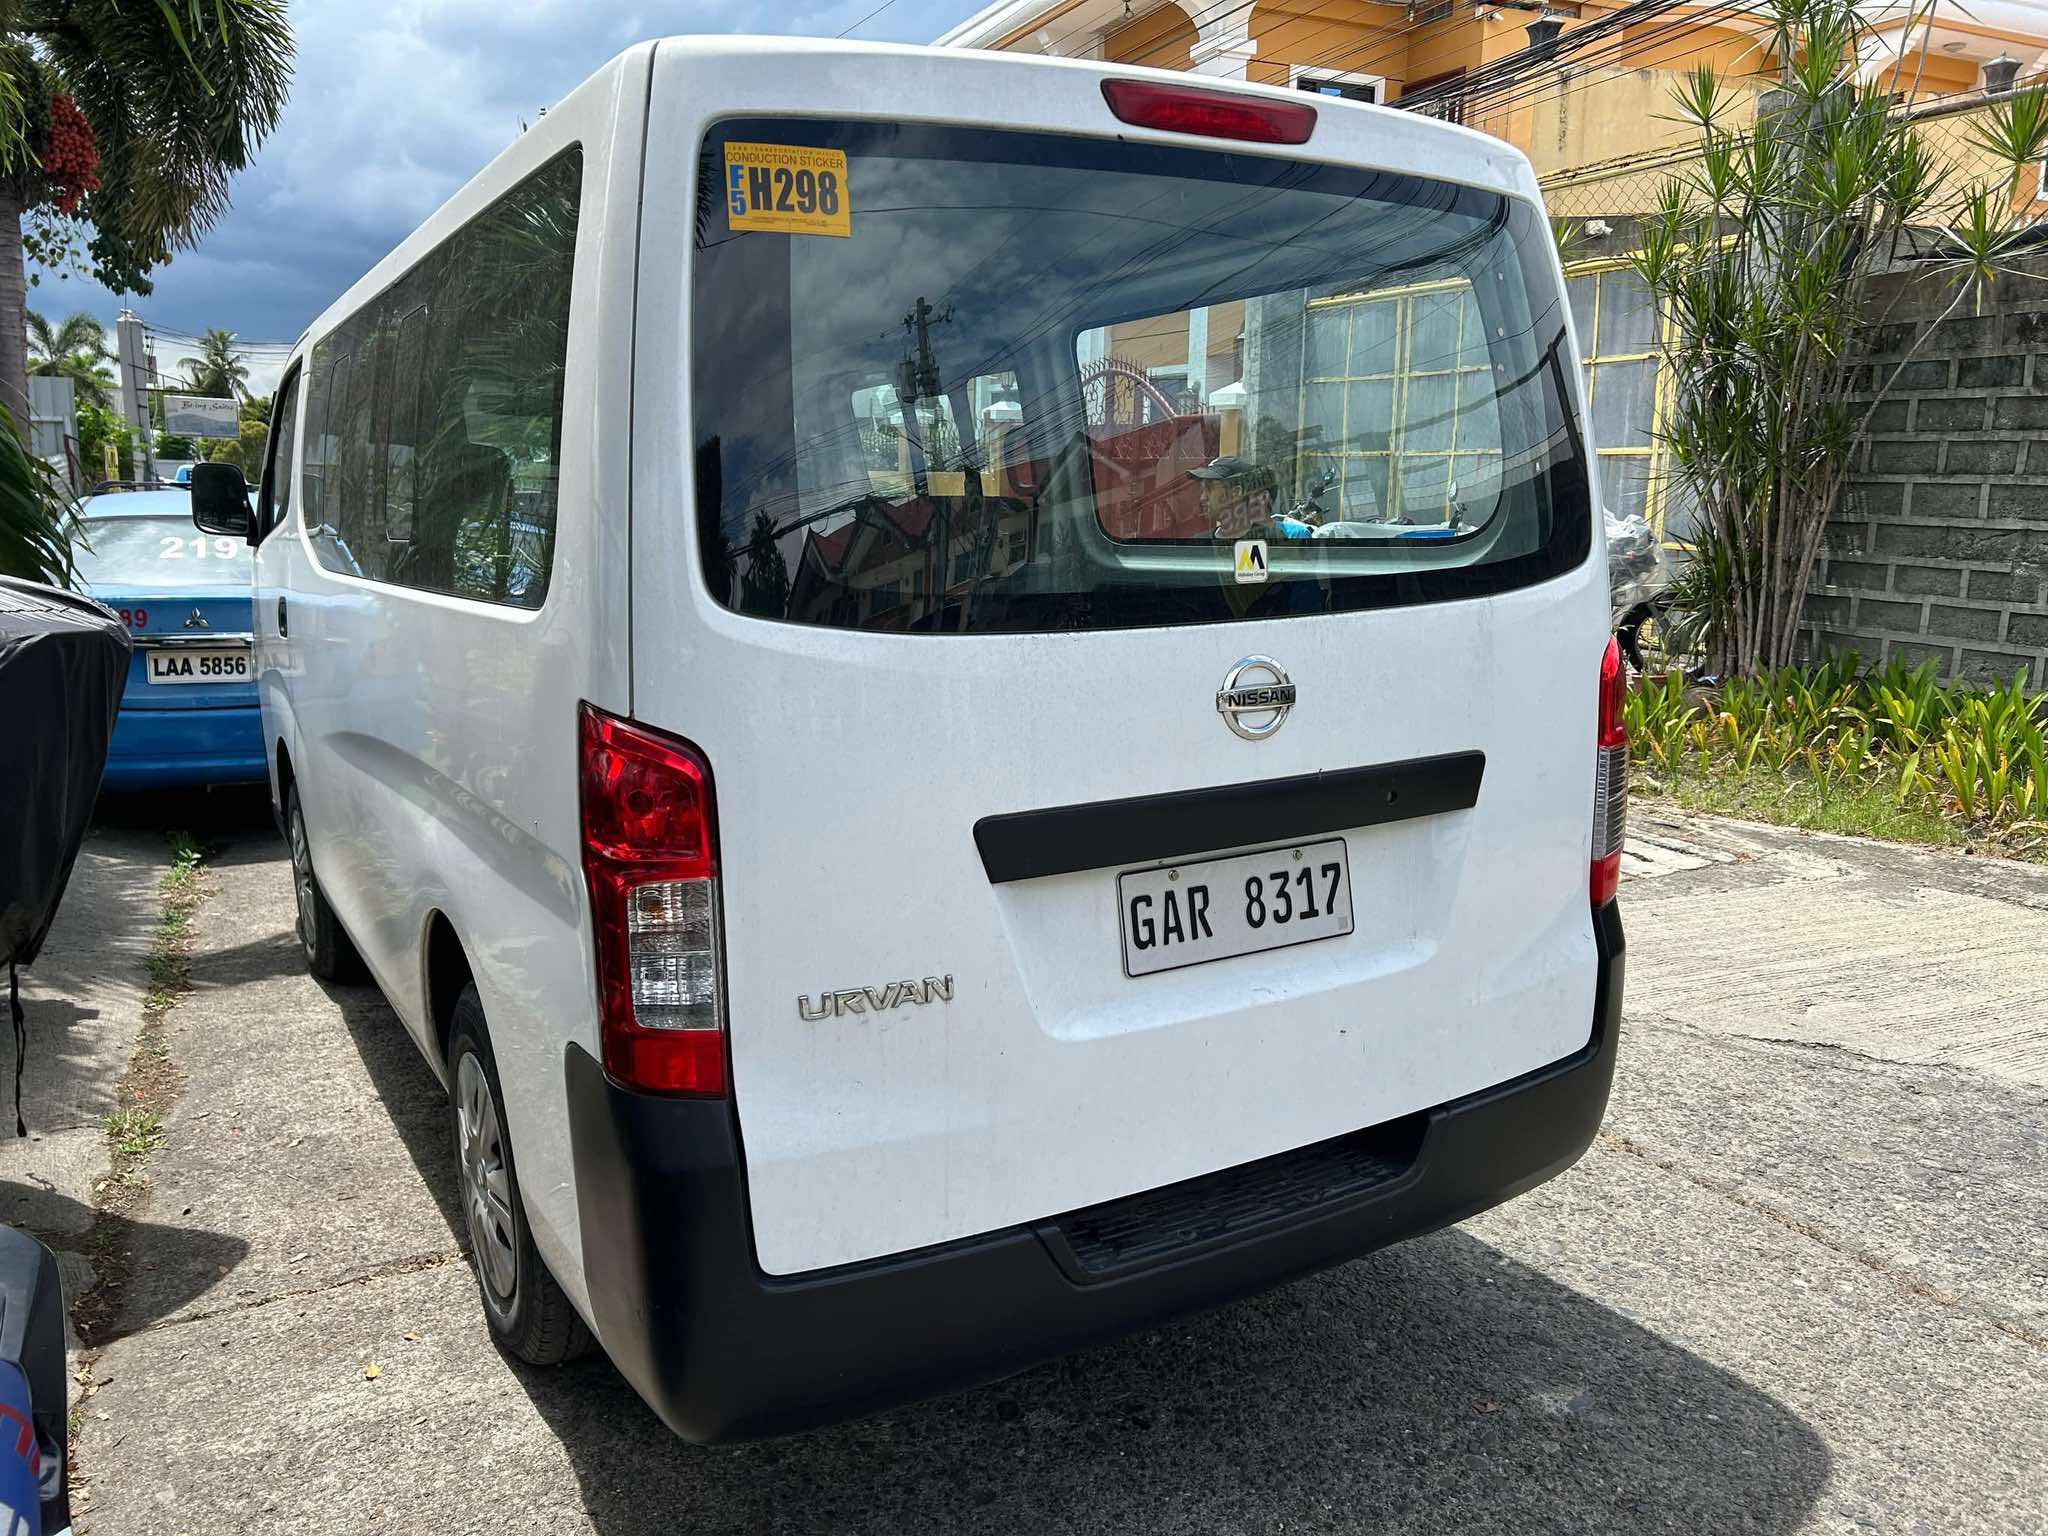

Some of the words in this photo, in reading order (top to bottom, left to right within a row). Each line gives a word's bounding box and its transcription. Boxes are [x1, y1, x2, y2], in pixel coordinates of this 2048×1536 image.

[726, 151, 797, 165] CONDUCTION
[800, 155, 844, 169] STICKER
[748, 166, 839, 216] H298
[159, 536, 238, 560] 219
[153, 657, 194, 677] LAA
[200, 656, 247, 676] 5856
[1228, 689, 1291, 707] NISSAN
[1130, 884, 1213, 950] GAR
[1245, 862, 1341, 929] 8317
[798, 974, 954, 1022] URVAN
